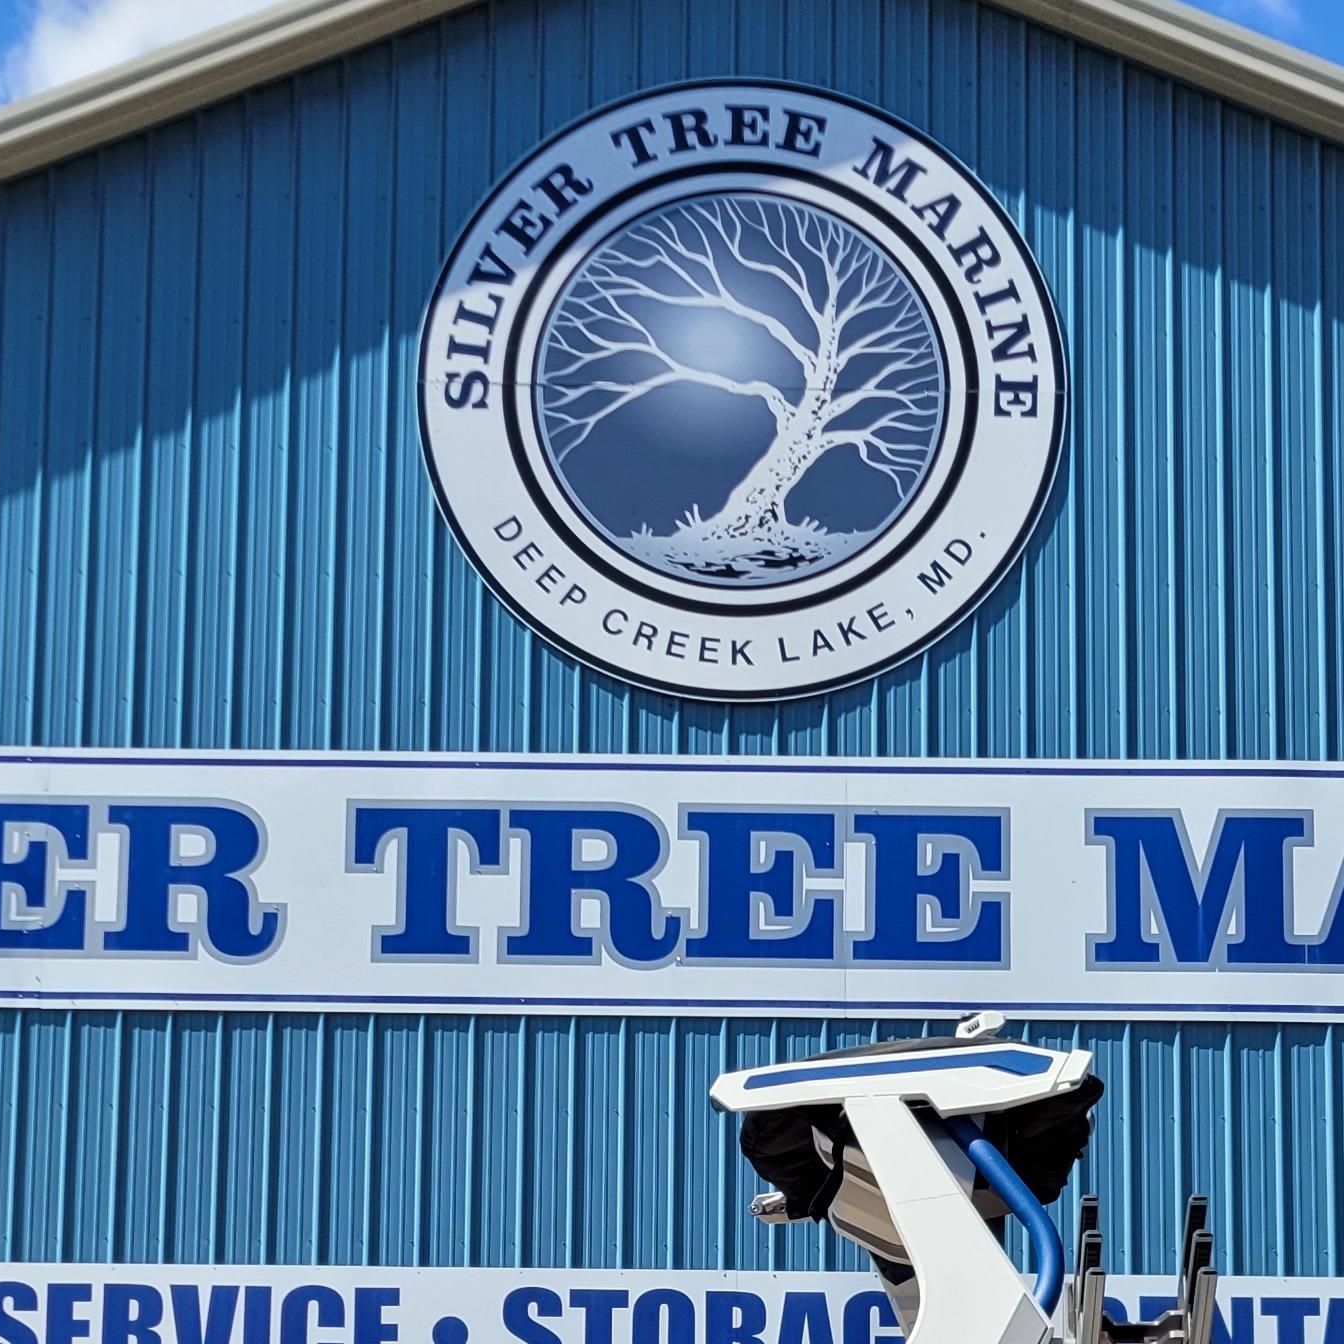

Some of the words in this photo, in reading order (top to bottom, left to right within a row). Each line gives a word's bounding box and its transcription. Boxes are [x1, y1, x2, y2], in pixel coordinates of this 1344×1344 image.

[444, 162, 594, 412] SILVER
[612, 104, 828, 170] TREE
[852, 136, 1040, 420] MARINE
[493, 515, 588, 608] DEEP
[601, 608, 755, 667] CREEK
[778, 603, 916, 662] LAKE,
[915, 528, 988, 595] MD.
[346, 798, 1012, 966] TREE
